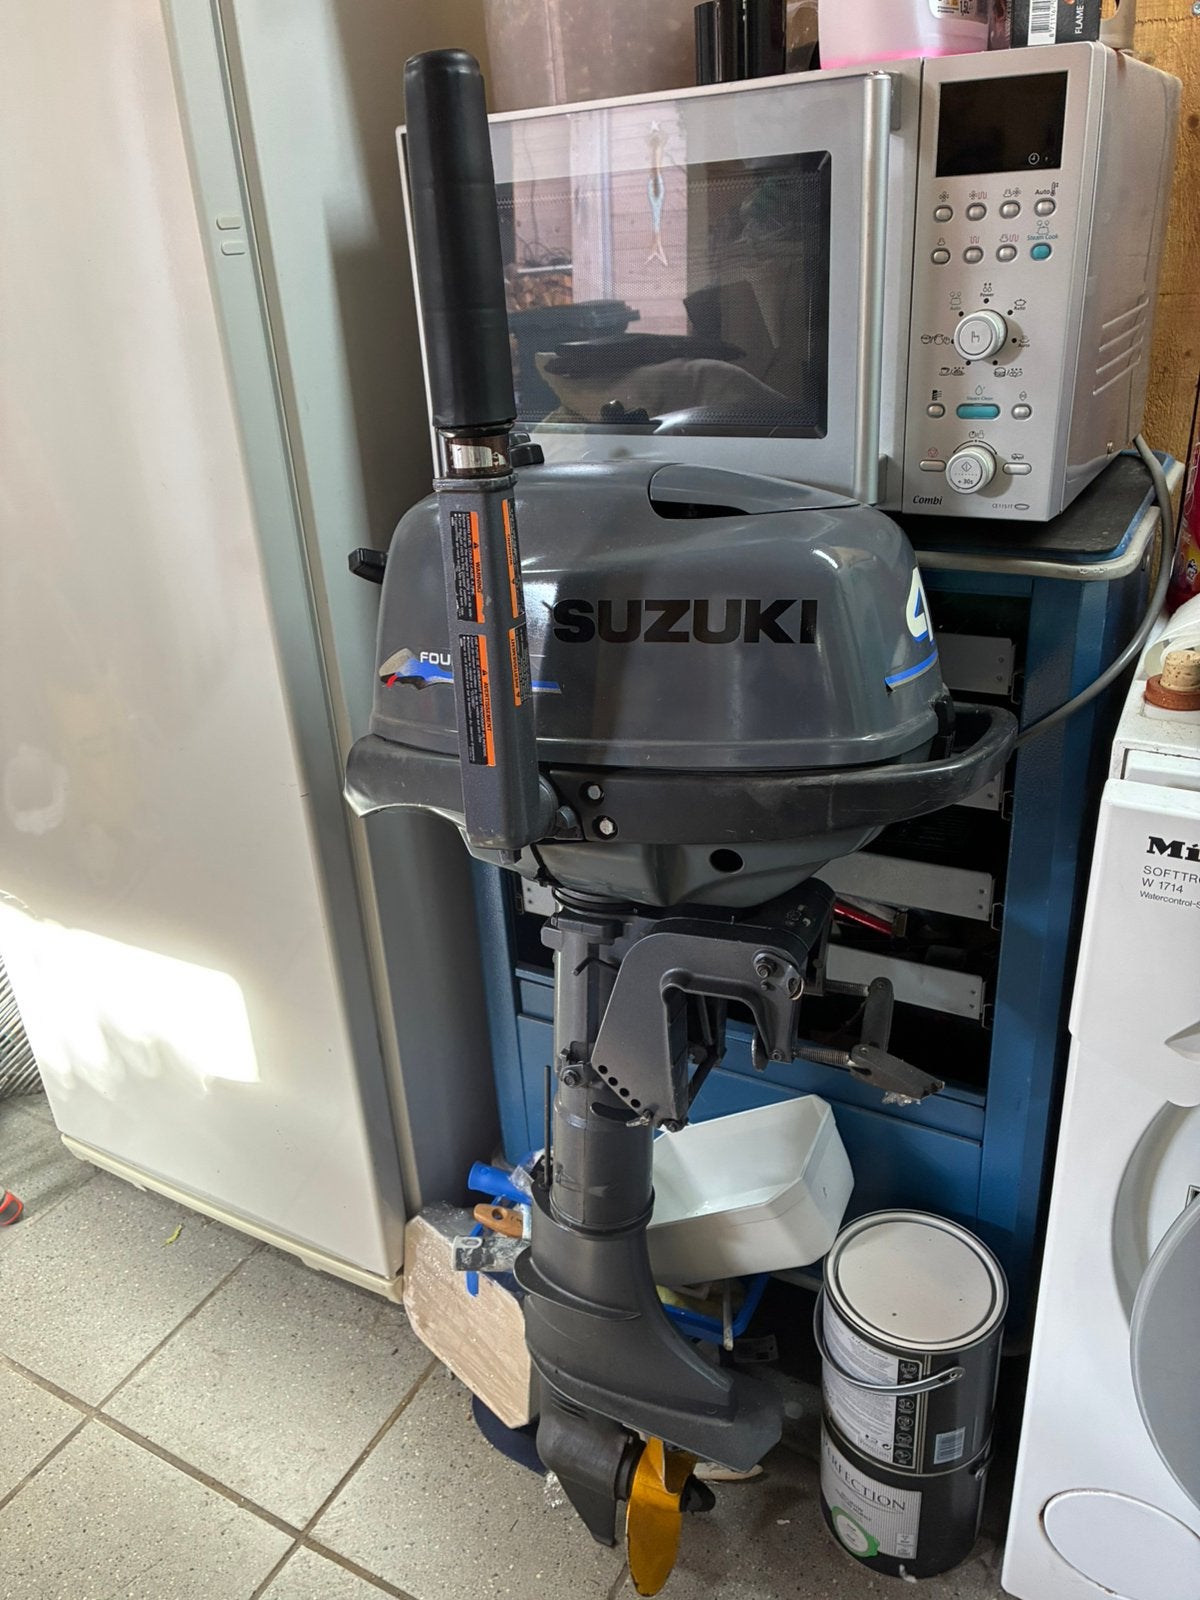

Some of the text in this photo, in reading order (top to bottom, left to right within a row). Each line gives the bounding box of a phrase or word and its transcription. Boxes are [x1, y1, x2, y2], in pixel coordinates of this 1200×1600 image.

[912, 495, 943, 505] Combi
[552, 599, 819, 645] SUZUKI
[420, 651, 451, 666] FOU
[1143, 865, 1200, 884] SOFTTR
[1142, 877, 1183, 894] W 1714
